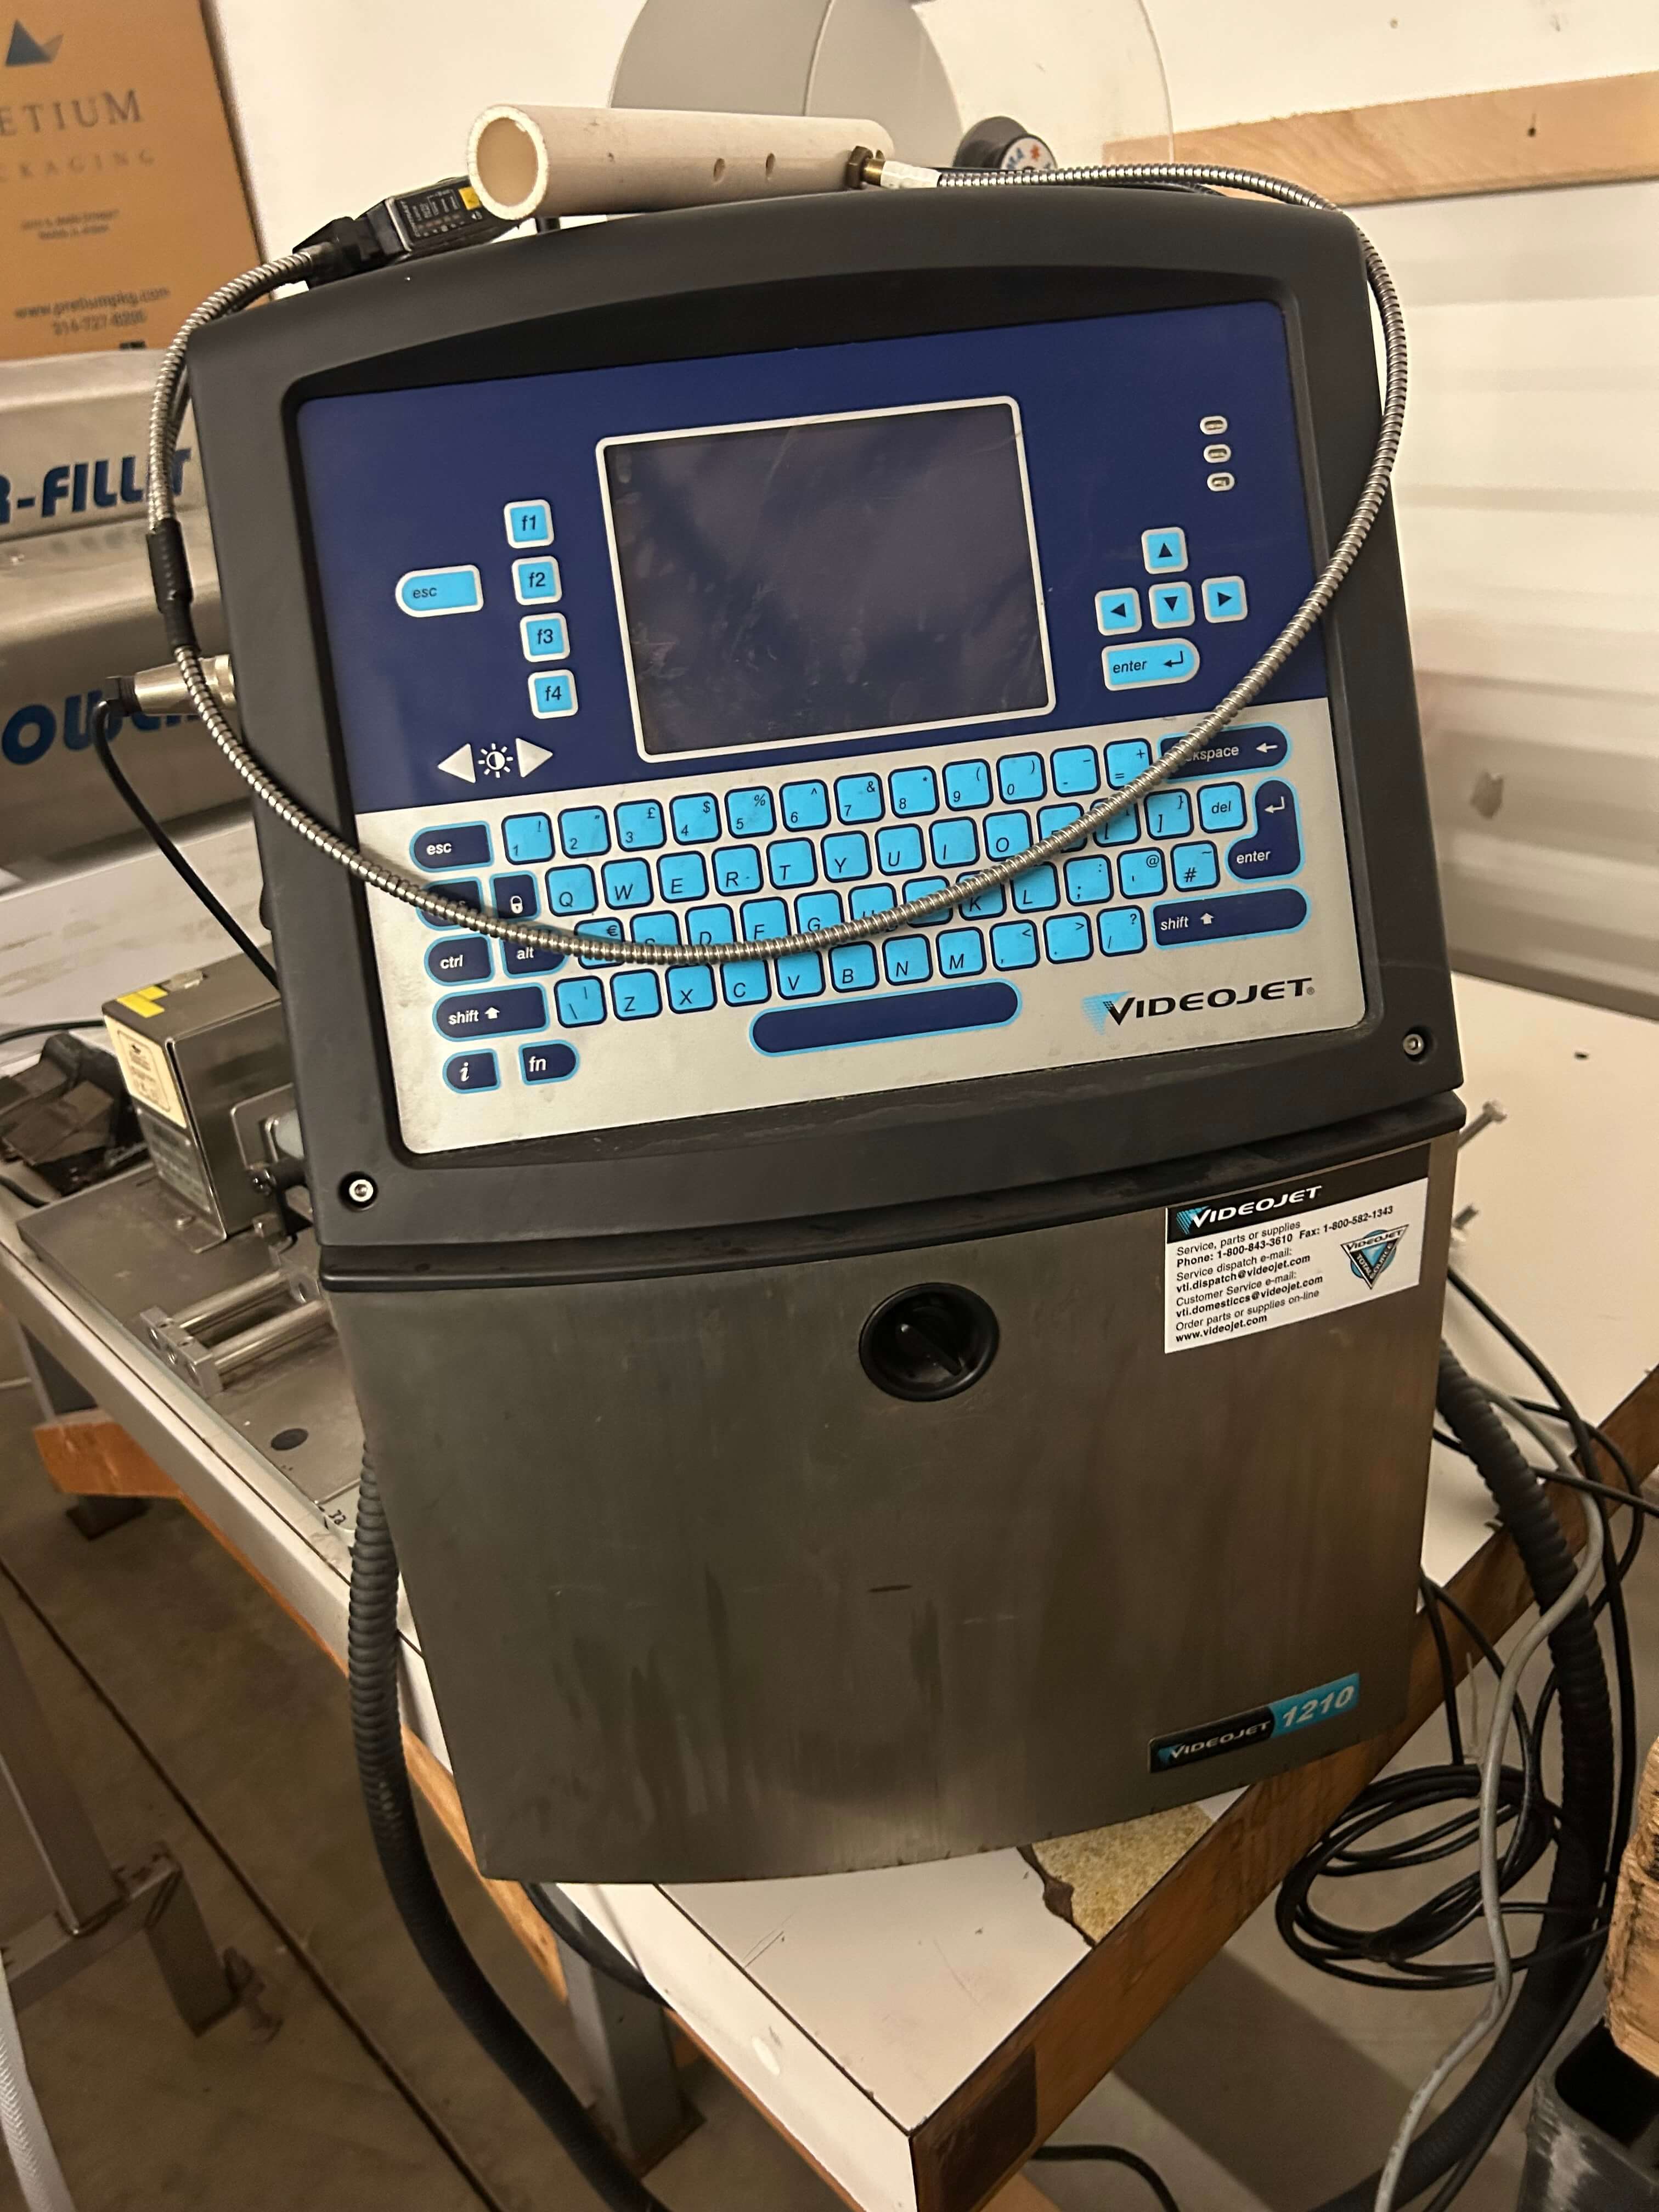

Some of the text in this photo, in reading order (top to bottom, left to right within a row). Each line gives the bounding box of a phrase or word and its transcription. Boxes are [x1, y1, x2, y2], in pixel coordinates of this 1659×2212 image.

[522, 515, 537, 531] f1
[528, 572, 546, 588] f2
[413, 586, 437, 599] esc
[537, 629, 554, 645] f3
[1113, 659, 1147, 674] enter
[545, 686, 562, 702] f4
[867, 781, 875, 793] &
[754, 794, 766, 806] %
[900, 798, 906, 809] 8
[953, 791, 961, 802] 9
[647, 808, 656, 820] £
[703, 801, 710, 813] $
[844, 805, 851, 817] 7
[1211, 800, 1231, 814] del
[736, 819, 743, 830] 5
[791, 811, 798, 823] 6
[625, 832, 633, 843] 3
[681, 825, 689, 836] 4
[426, 842, 452, 855] esc
[513, 845, 519, 856] 1
[570, 838, 578, 850] 2
[996, 837, 1009, 853] O
[888, 851, 900, 866] U
[943, 844, 947, 860] I
[1236, 849, 1272, 864] enter
[834, 858, 847, 873] Y
[1146, 855, 1159, 868] @
[726, 872, 738, 887] R
[780, 865, 791, 880] T
[1184, 867, 1197, 882] #
[615, 883, 633, 900] W
[671, 879, 683, 894] E
[559, 891, 573, 907] Q
[969, 897, 982, 912] K
[1023, 890, 1033, 905] L
[808, 917, 820, 932] G
[1130, 913, 1137, 925] ?
[1160, 916, 1189, 931] shift
[606, 925, 617, 936] €
[754, 924, 765, 940] F
[516, 946, 534, 960] alt
[440, 955, 463, 969] ctrl
[896, 961, 909, 977] N
[949, 953, 964, 970] M
[788, 975, 800, 991] V
[843, 968, 854, 984] B
[680, 989, 693, 1005] X
[733, 982, 746, 997] C
[624, 996, 635, 1012] Z
[448, 1009, 479, 1025] shift
[528, 1056, 547, 1072] fn
[1192, 1186, 1322, 1228] VIDEOJET
[1177, 1206, 1393, 1267] Phone: 1-800-843-3610 Fax: 1-800-582-1343
[1177, 1221, 1300, 1256] Service, parts or supplies
[1346, 1229, 1403, 1250] VIDEOJET
[1177, 1248, 1292, 1282] Service dispatch e-mail:
[1177, 1255, 1310, 1293] vti.dispatch@videojet.com
[1176, 1271, 1296, 1306] Customer Service e-mail:
[1176, 1276, 1323, 1317] vti.domesticcs@videojet.com
[1176, 1319, 1204, 1331] Order
[1207, 1313, 1231, 1326] parts
[1247, 1299, 1285, 1314] supplies
[1289, 1290, 1319, 1304] on-line
[1176, 1314, 1267, 1342] www.videojet.com
[1283, 1685, 1355, 1726] 1210
[1169, 1720, 1271, 1759] VIDEOJET
